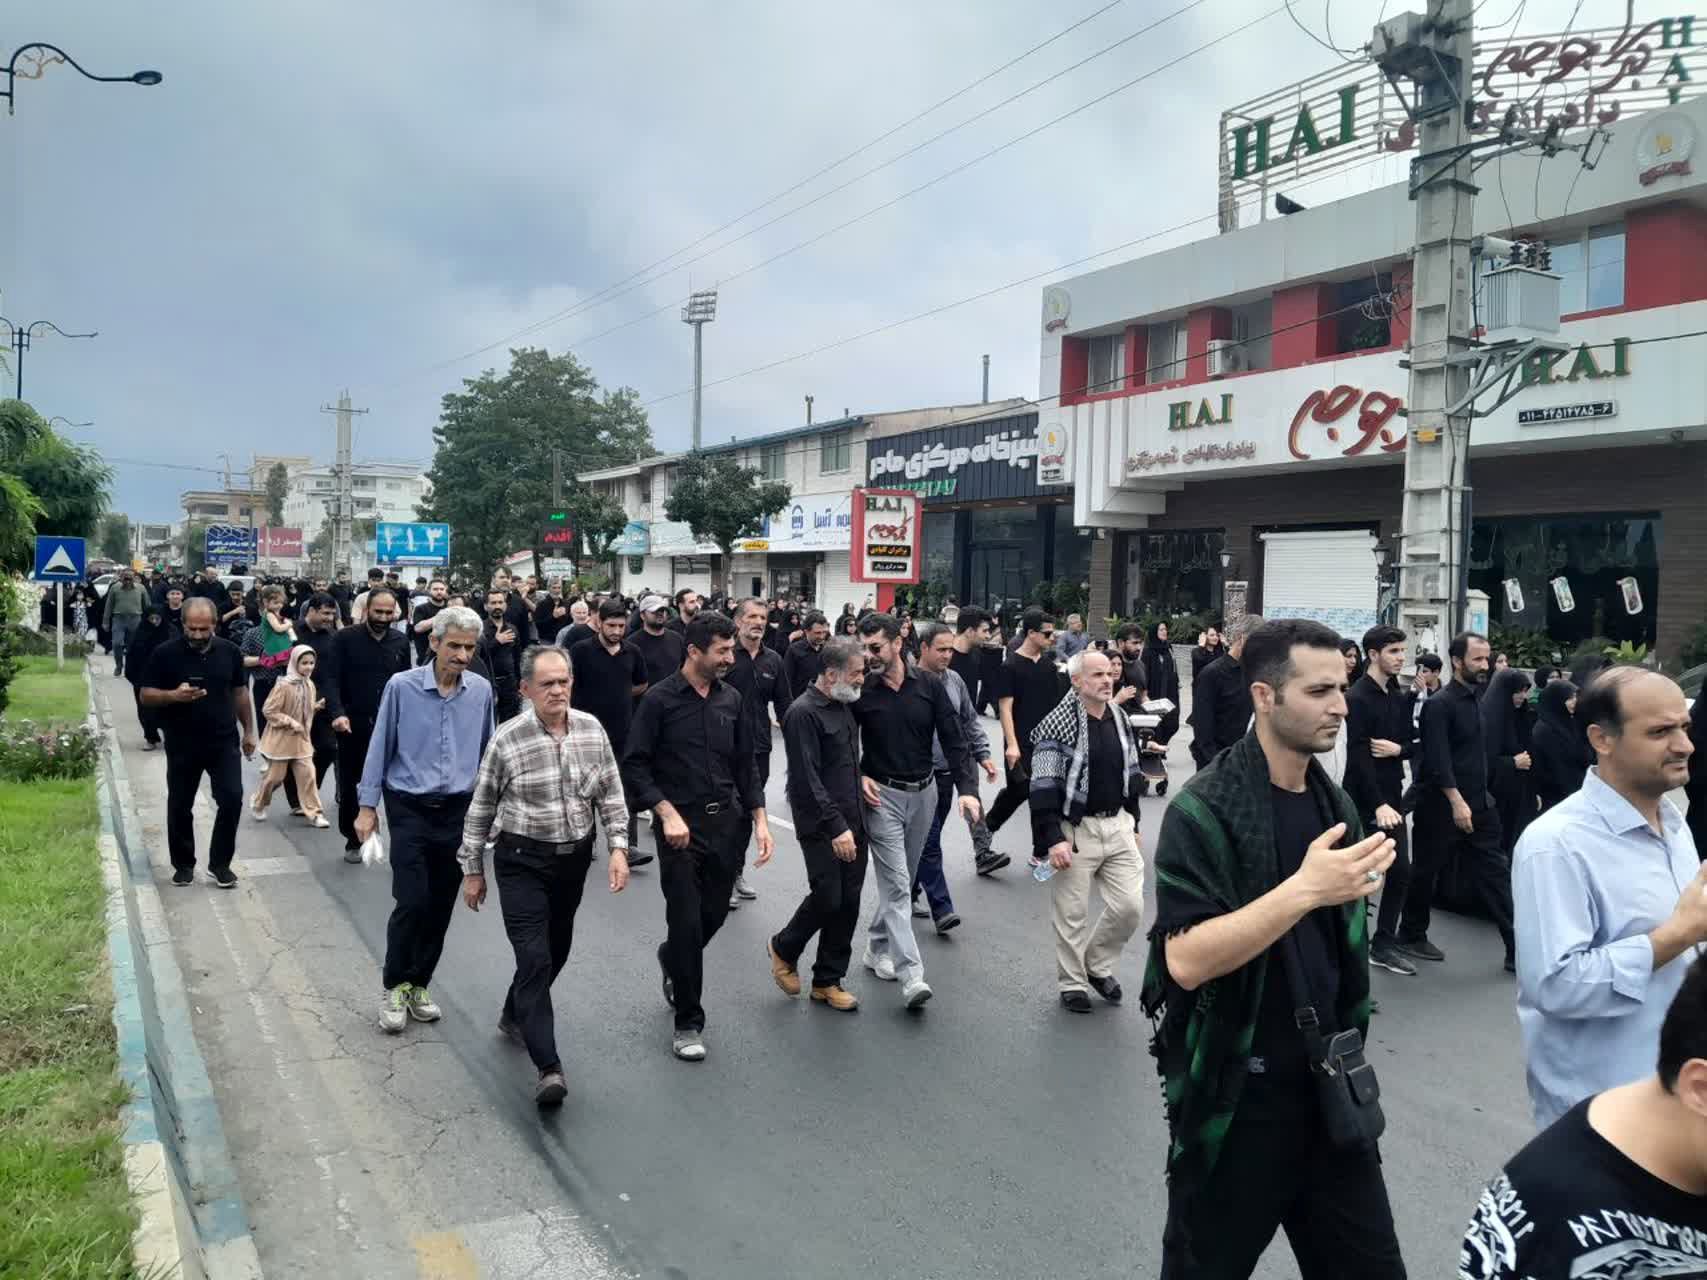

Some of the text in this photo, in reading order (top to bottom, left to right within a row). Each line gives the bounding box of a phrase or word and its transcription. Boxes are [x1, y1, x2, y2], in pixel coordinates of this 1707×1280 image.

[1231, 83, 1360, 180] H.A.I
[1168, 393, 1234, 430] H.A.I
[905, 442, 971, 479] مرکزی
